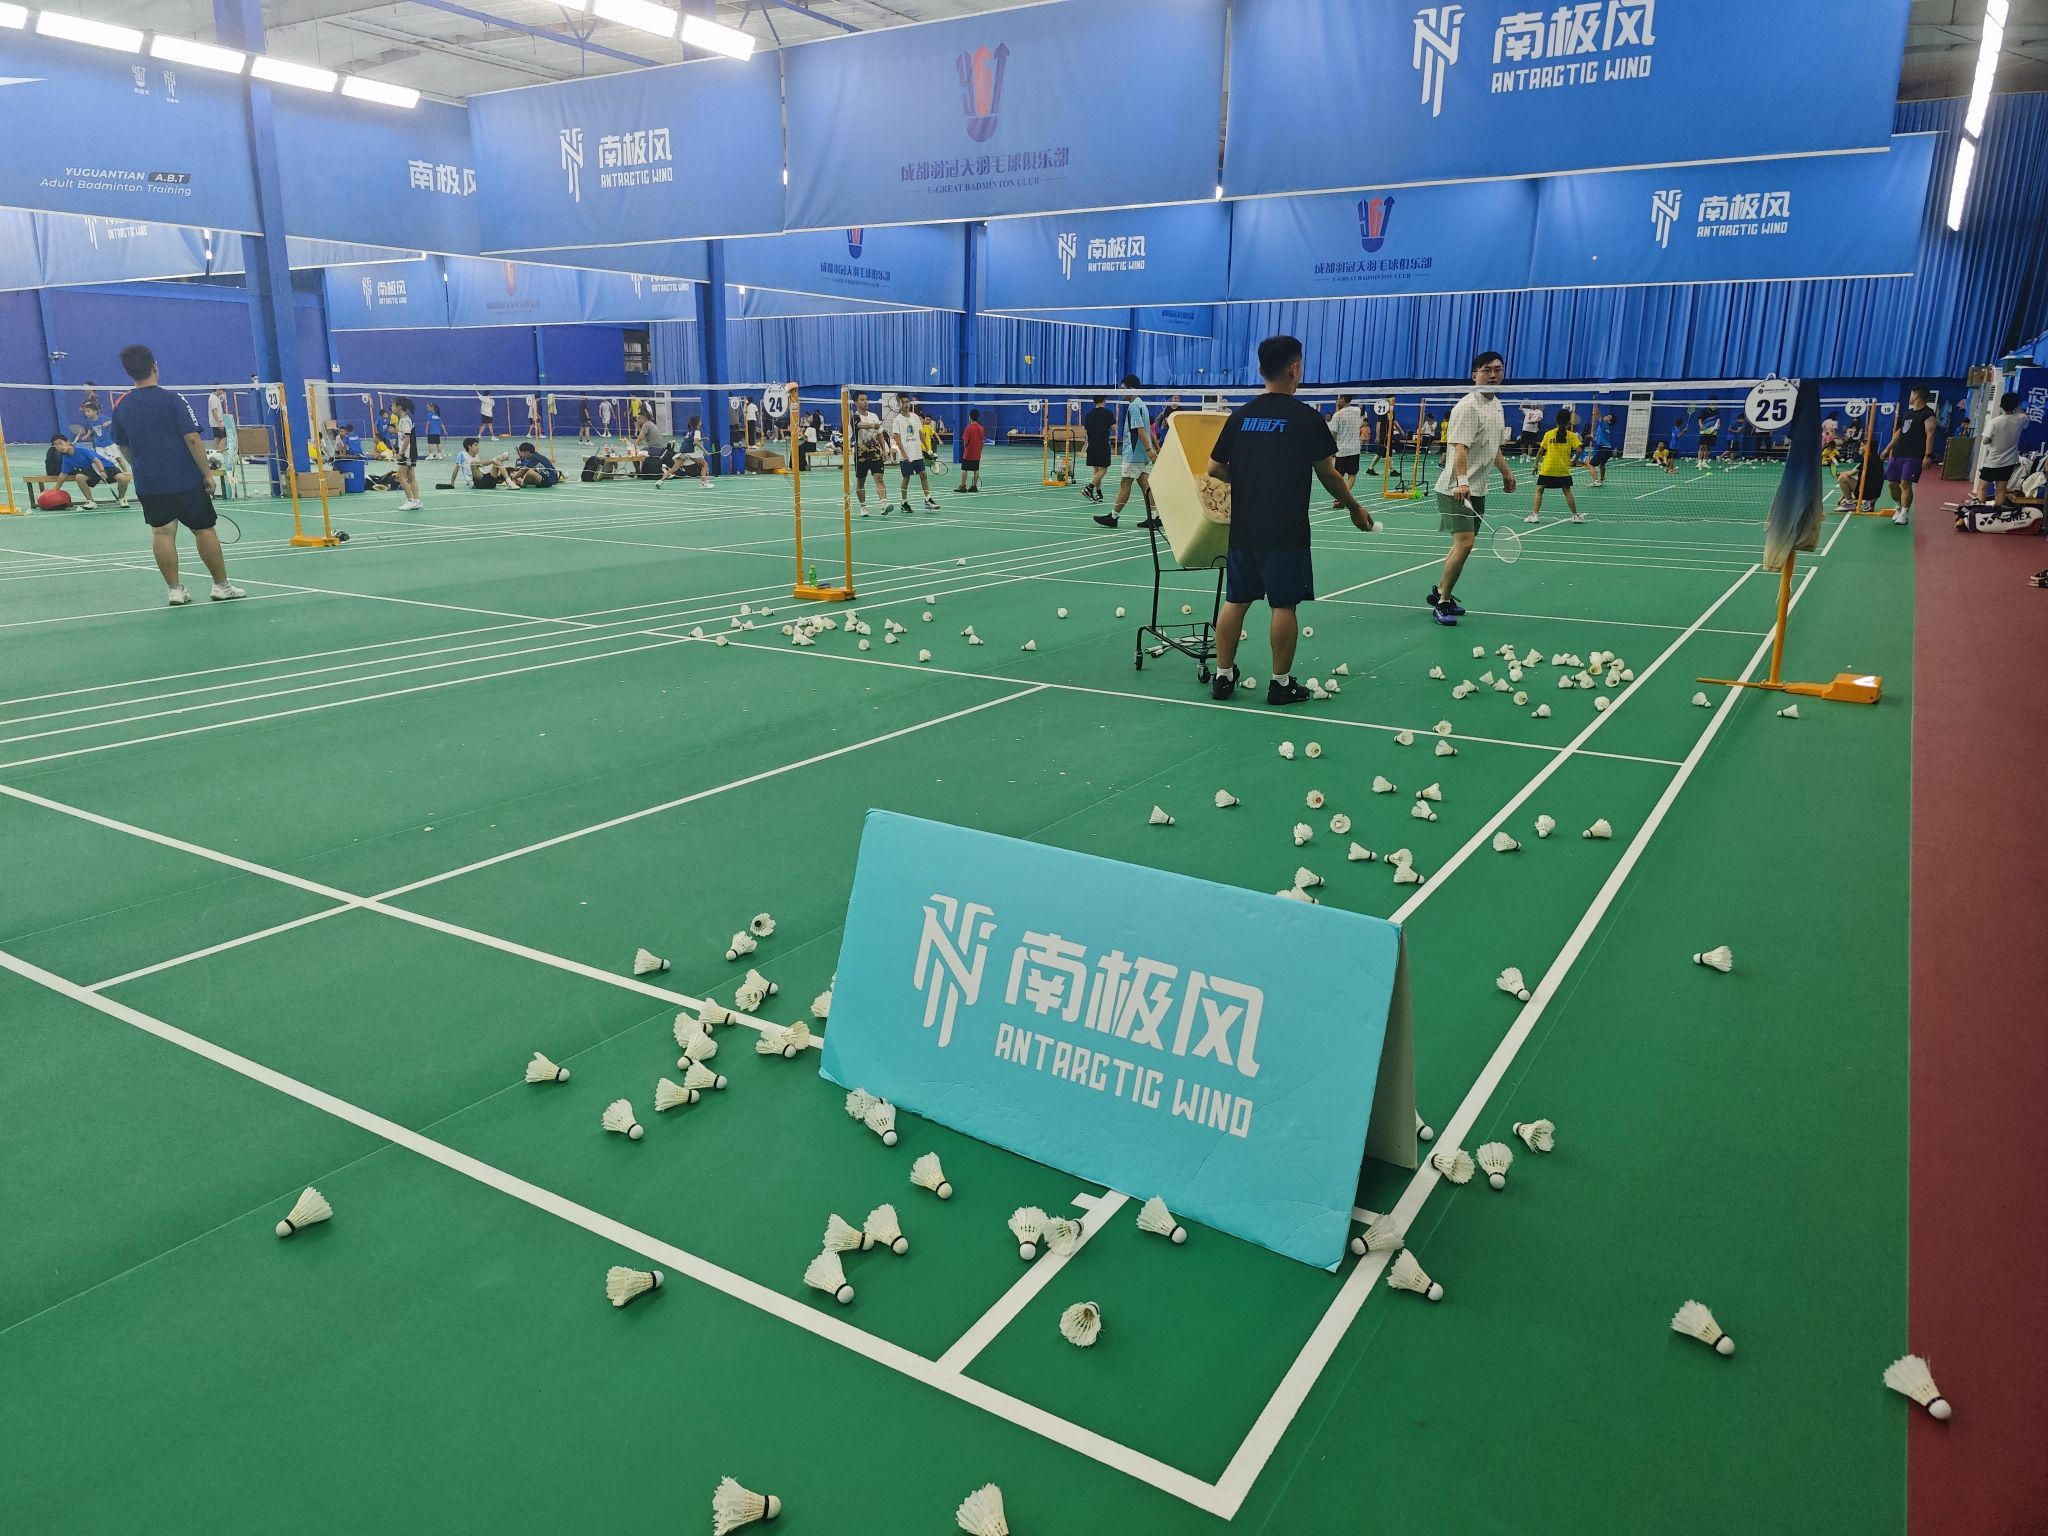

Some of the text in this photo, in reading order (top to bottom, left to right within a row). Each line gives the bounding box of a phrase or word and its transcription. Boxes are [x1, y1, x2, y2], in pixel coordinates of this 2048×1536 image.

[1492, 0, 1656, 64] 南极风
[1491, 55, 1652, 93] ANTARCTIC WIND
[599, 128, 673, 168] 南极风
[65, 166, 145, 180] YUGUANTIAN
[600, 167, 673, 189] ANTARCTIC WIND
[40, 178, 192, 196] Adult Badminton Training
[1698, 191, 1791, 222] 南极风
[1696, 221, 1788, 238] ANTARCTIC WIND
[1088, 236, 1146, 259] 南极风
[1088, 260, 1145, 272] ANTARCTIC WIND
[269, 393, 278, 405] 23
[768, 397, 783, 412] 24
[1377, 405, 1386, 413] 21
[1755, 398, 1787, 421] 25
[1849, 405, 1862, 415] 22
[1004, 931, 1265, 1078] 南极风
[994, 1022, 1255, 1139] ANTARCTIC WIND
